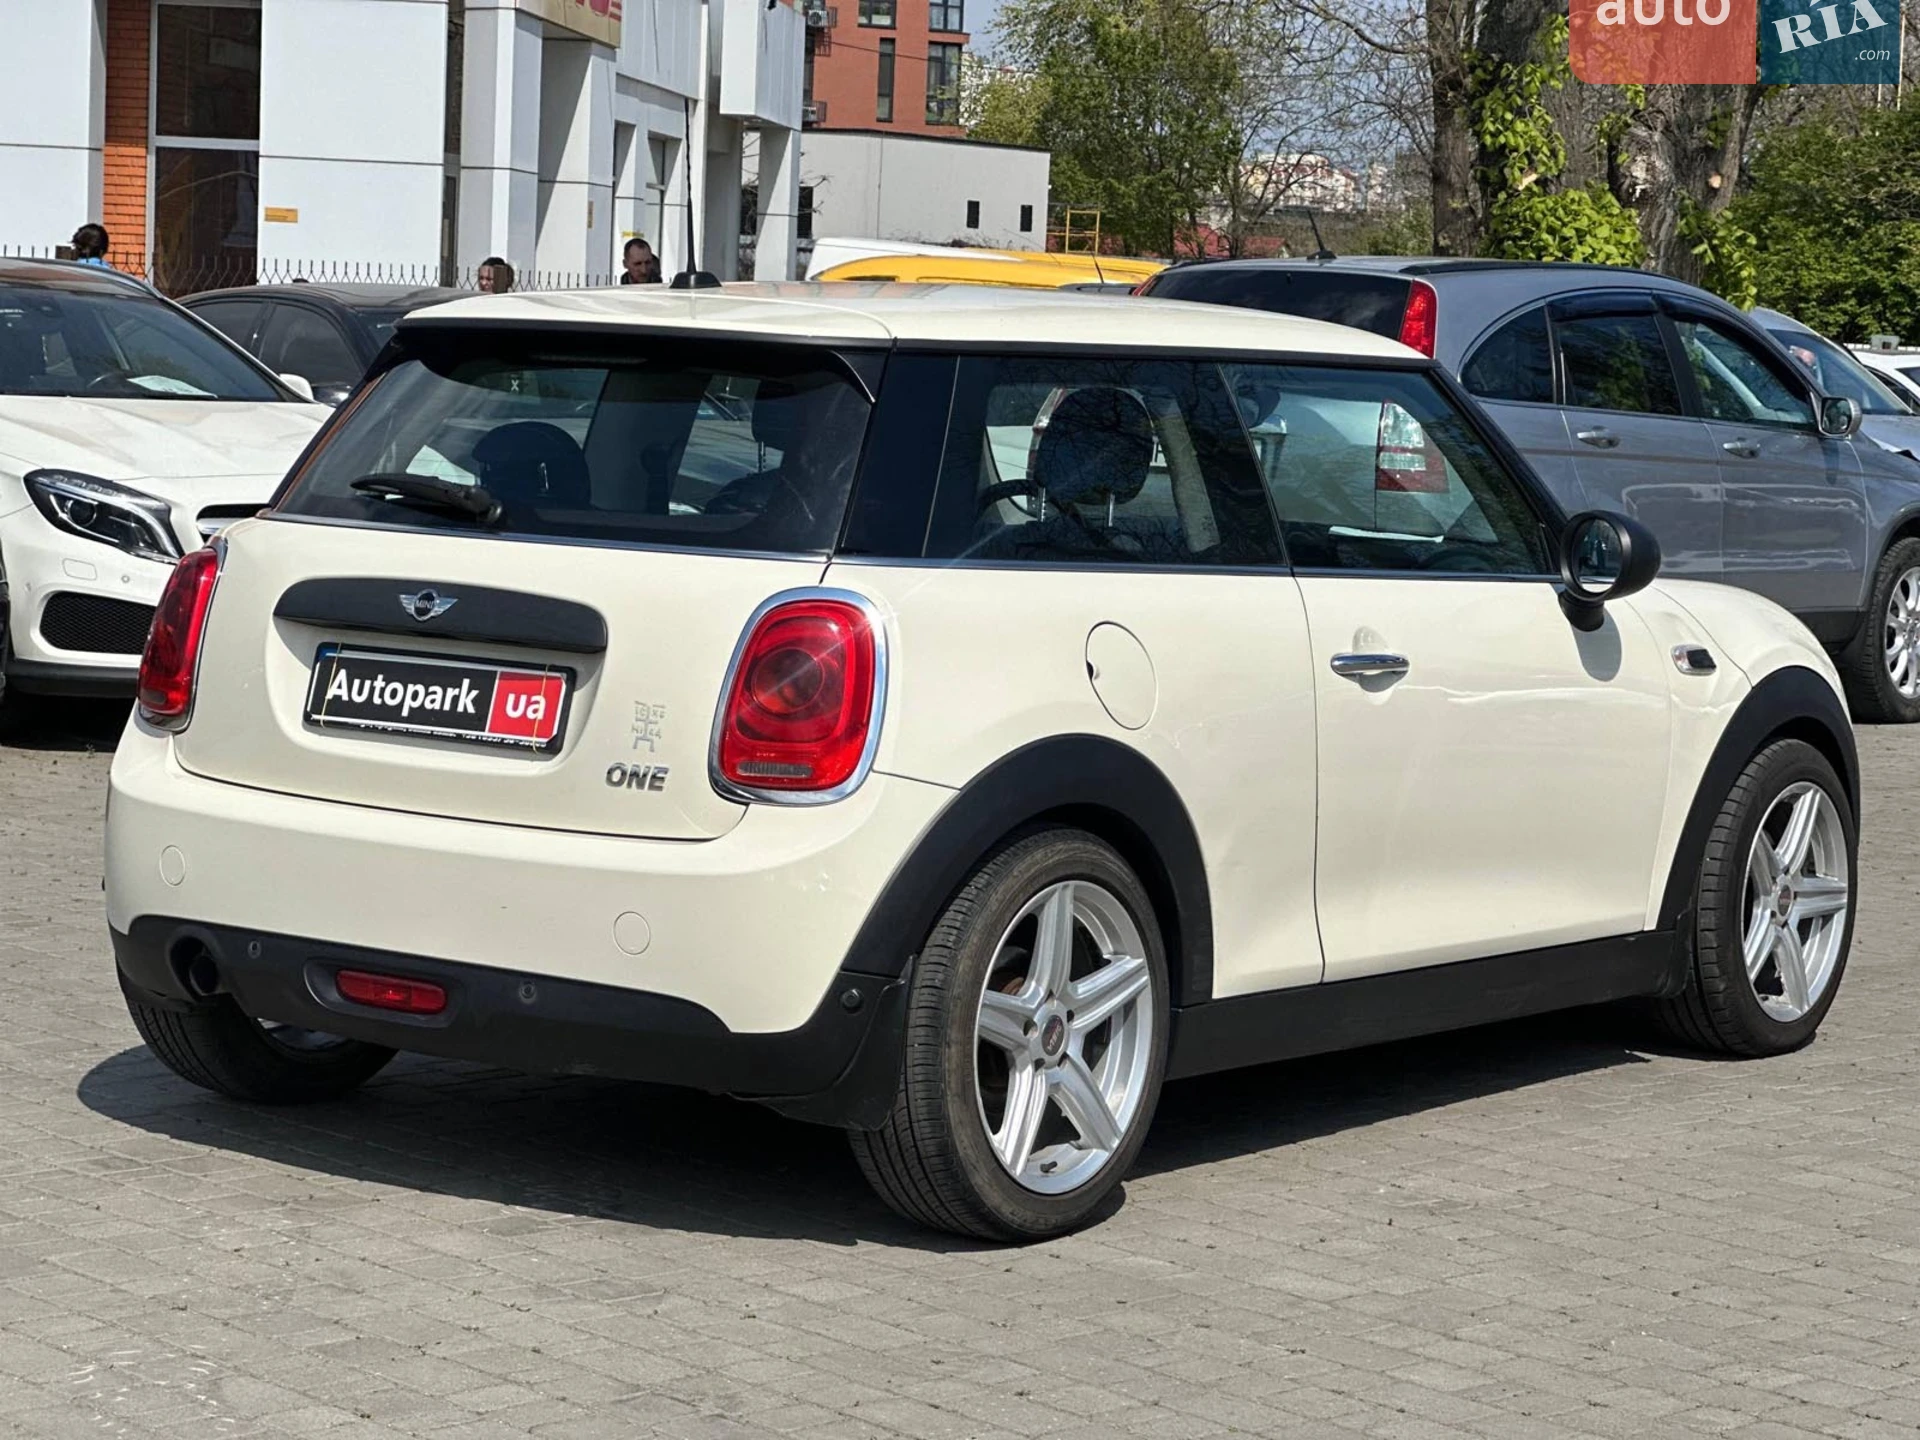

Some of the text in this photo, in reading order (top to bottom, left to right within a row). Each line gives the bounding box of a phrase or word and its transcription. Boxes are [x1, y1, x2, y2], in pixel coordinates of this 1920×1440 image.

[325, 668, 546, 721] Autopark ua
[606, 762, 669, 792] ONE
